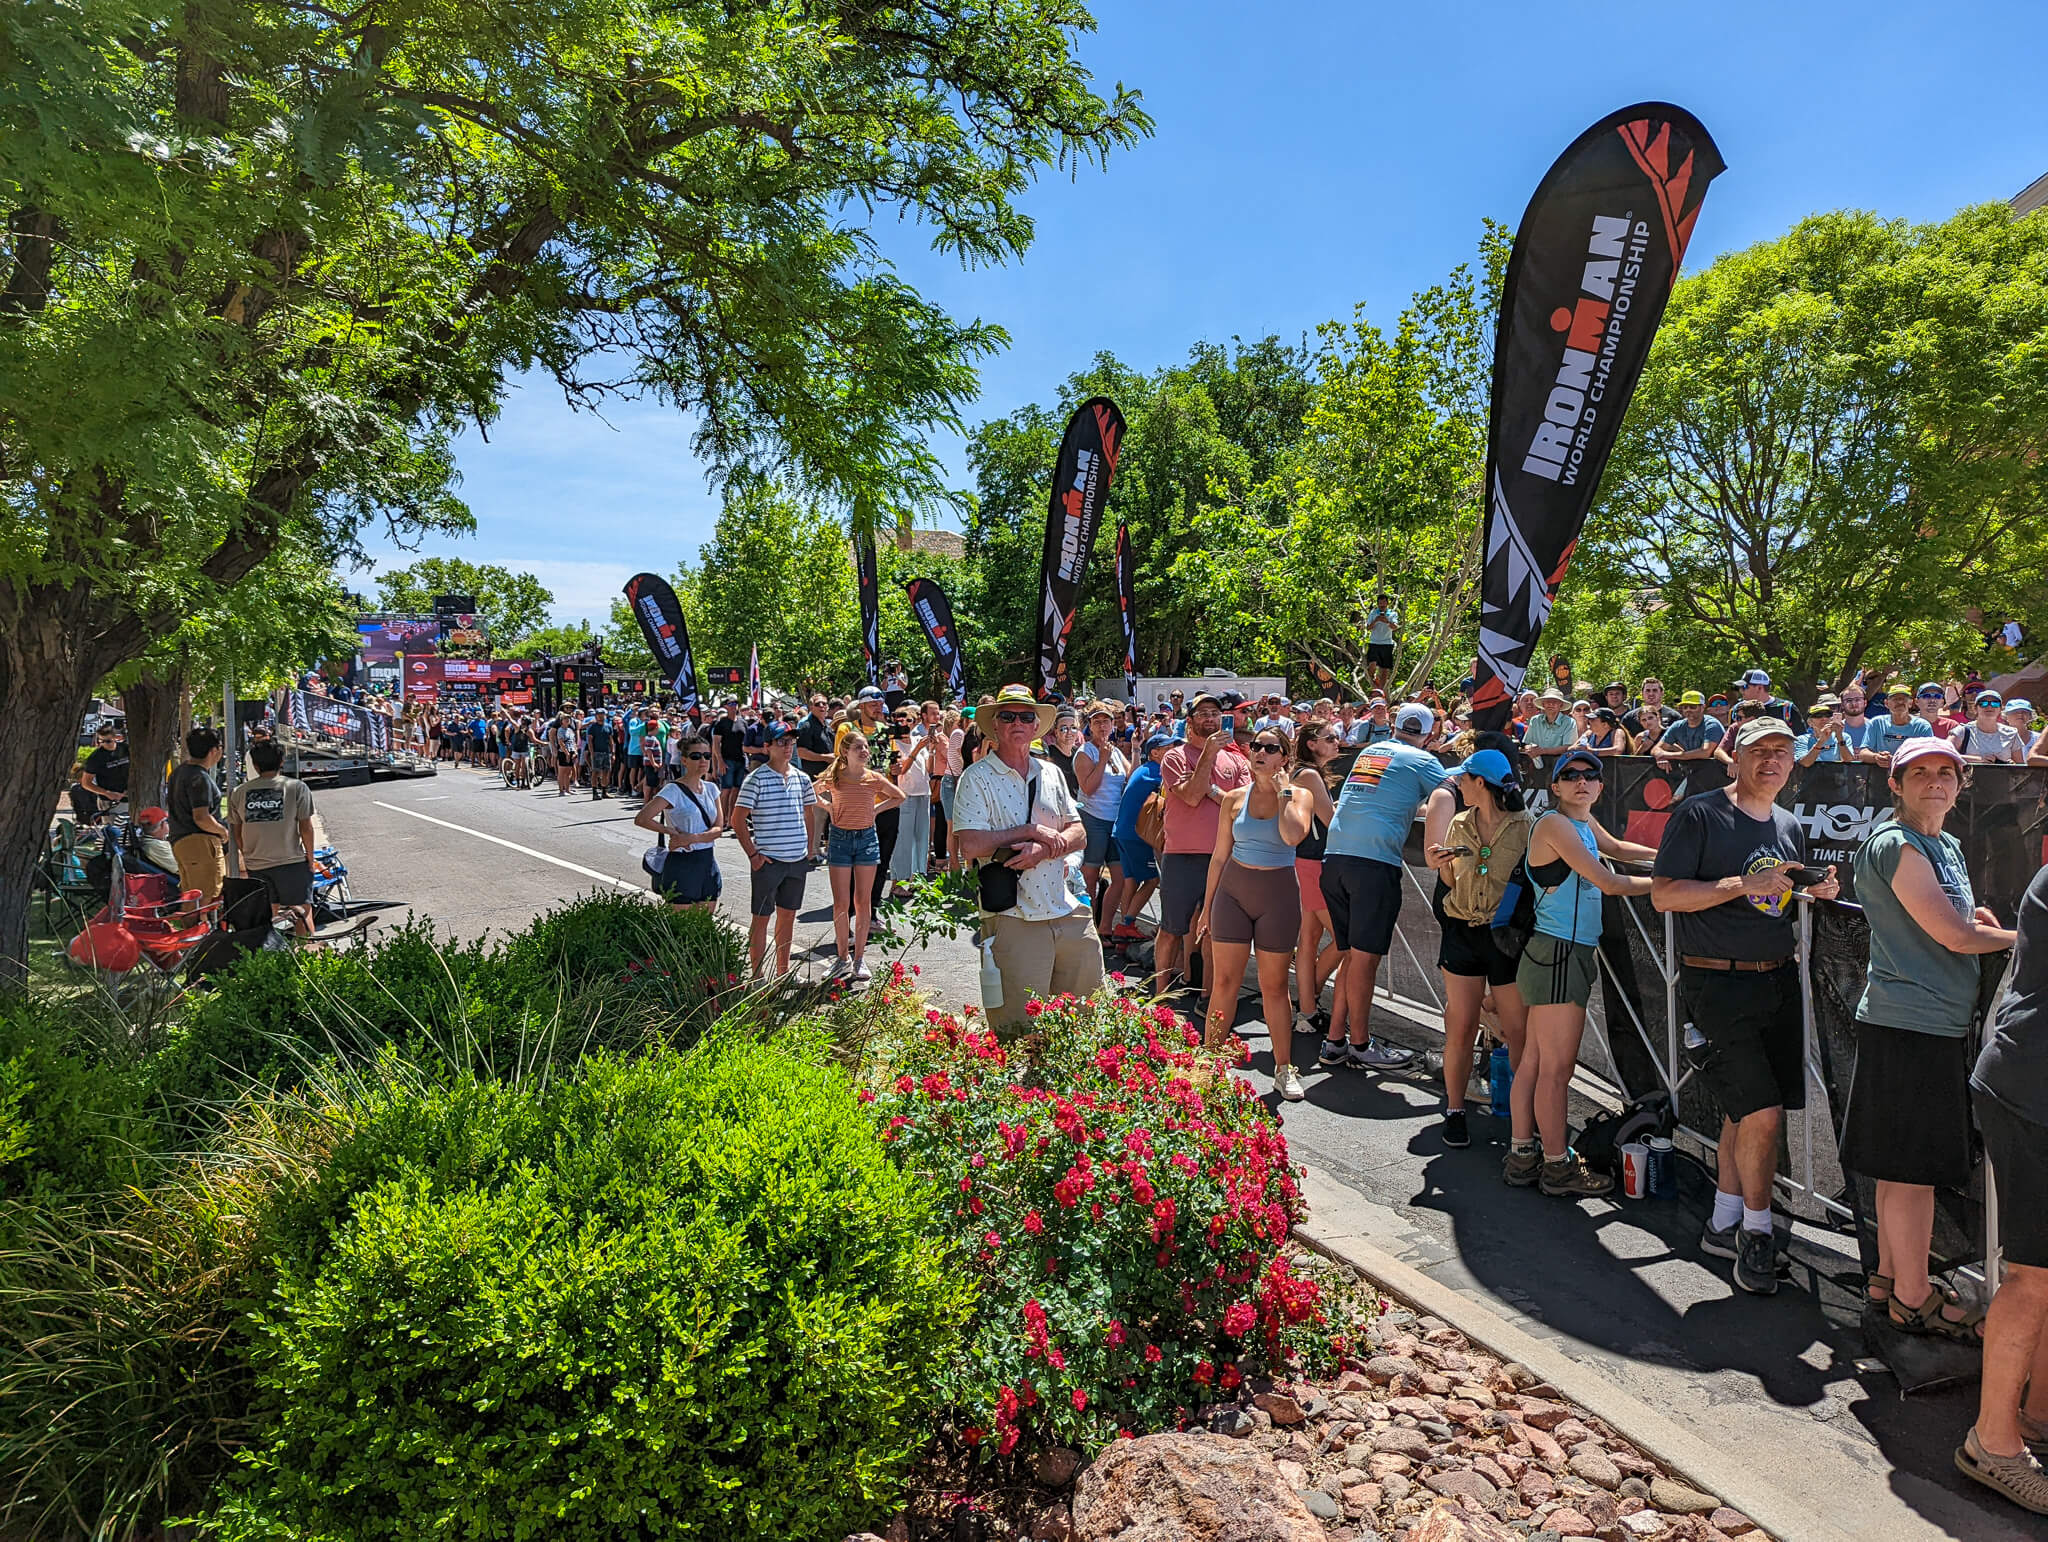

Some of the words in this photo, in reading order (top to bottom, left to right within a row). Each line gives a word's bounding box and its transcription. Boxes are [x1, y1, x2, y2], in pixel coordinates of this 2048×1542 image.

[1522, 215, 1632, 482] IRONMAN
[1562, 408, 1597, 486] WORLD
[1590, 221, 1650, 402] CHAMPIONSHIP
[1058, 450, 1092, 582] IRONMAN
[1072, 545, 1087, 584] WORLD
[1081, 454, 1101, 543] CHAMPIONSHIP
[643, 595, 682, 657] IRONMAN
[920, 598, 953, 655] IRONMAN
[247, 800, 282, 809] OAKLEY
[1793, 803, 1897, 842] HOK
[1812, 847, 1845, 863] TIME
[1847, 850, 1856, 863] T
